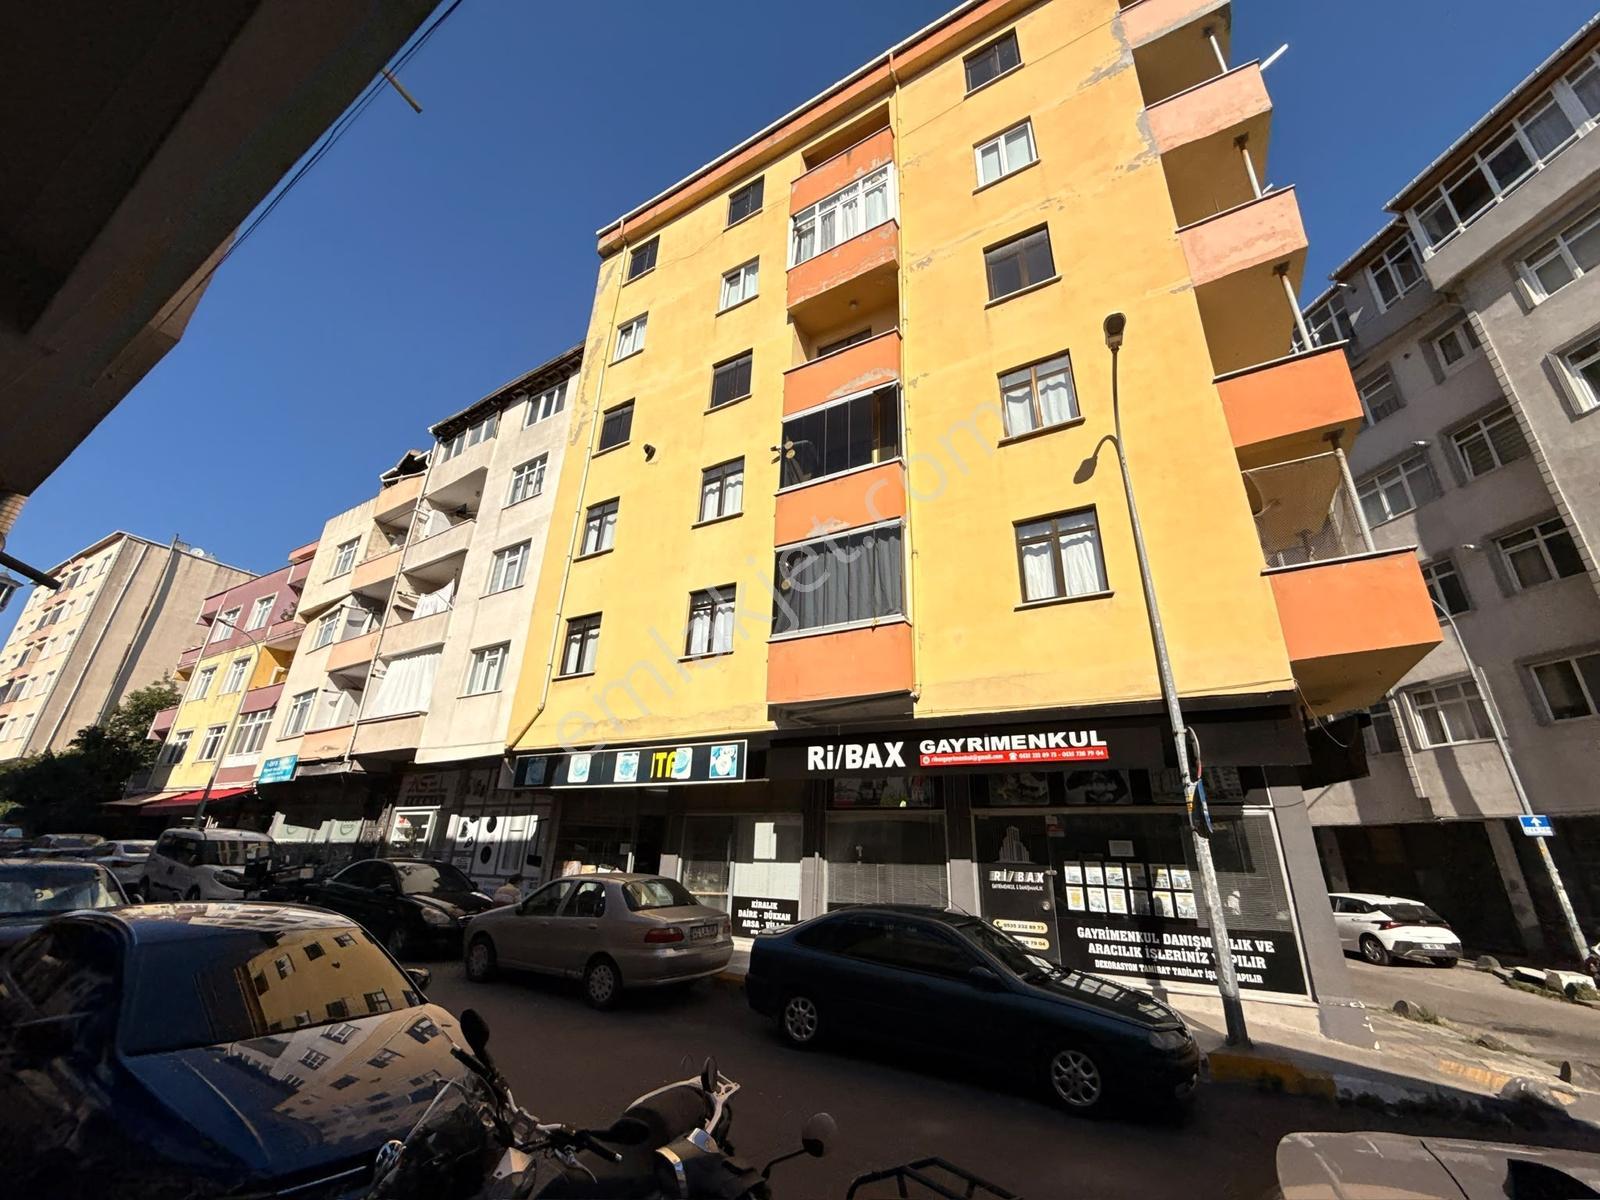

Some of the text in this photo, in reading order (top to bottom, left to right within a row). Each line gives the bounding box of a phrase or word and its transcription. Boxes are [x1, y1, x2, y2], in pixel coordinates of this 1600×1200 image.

[919, 730, 1108, 754] GAYRİMENKUL
[751, 900, 778, 910] KİRALIK
[737, 908, 758, 919] DAİRE
[763, 910, 791, 921] DÜKKAN
[742, 919, 760, 929] ARSA
[1077, 927, 1275, 953] GAYRİMENKUL DANIŞMLIK VE
[1088, 943, 1143, 958] ARACILIK
[1145, 945, 1210, 965] İŞLERİNİZ
[1095, 960, 1138, 972] DEKORASYON
[1172, 966, 1203, 978] TADİLAT
